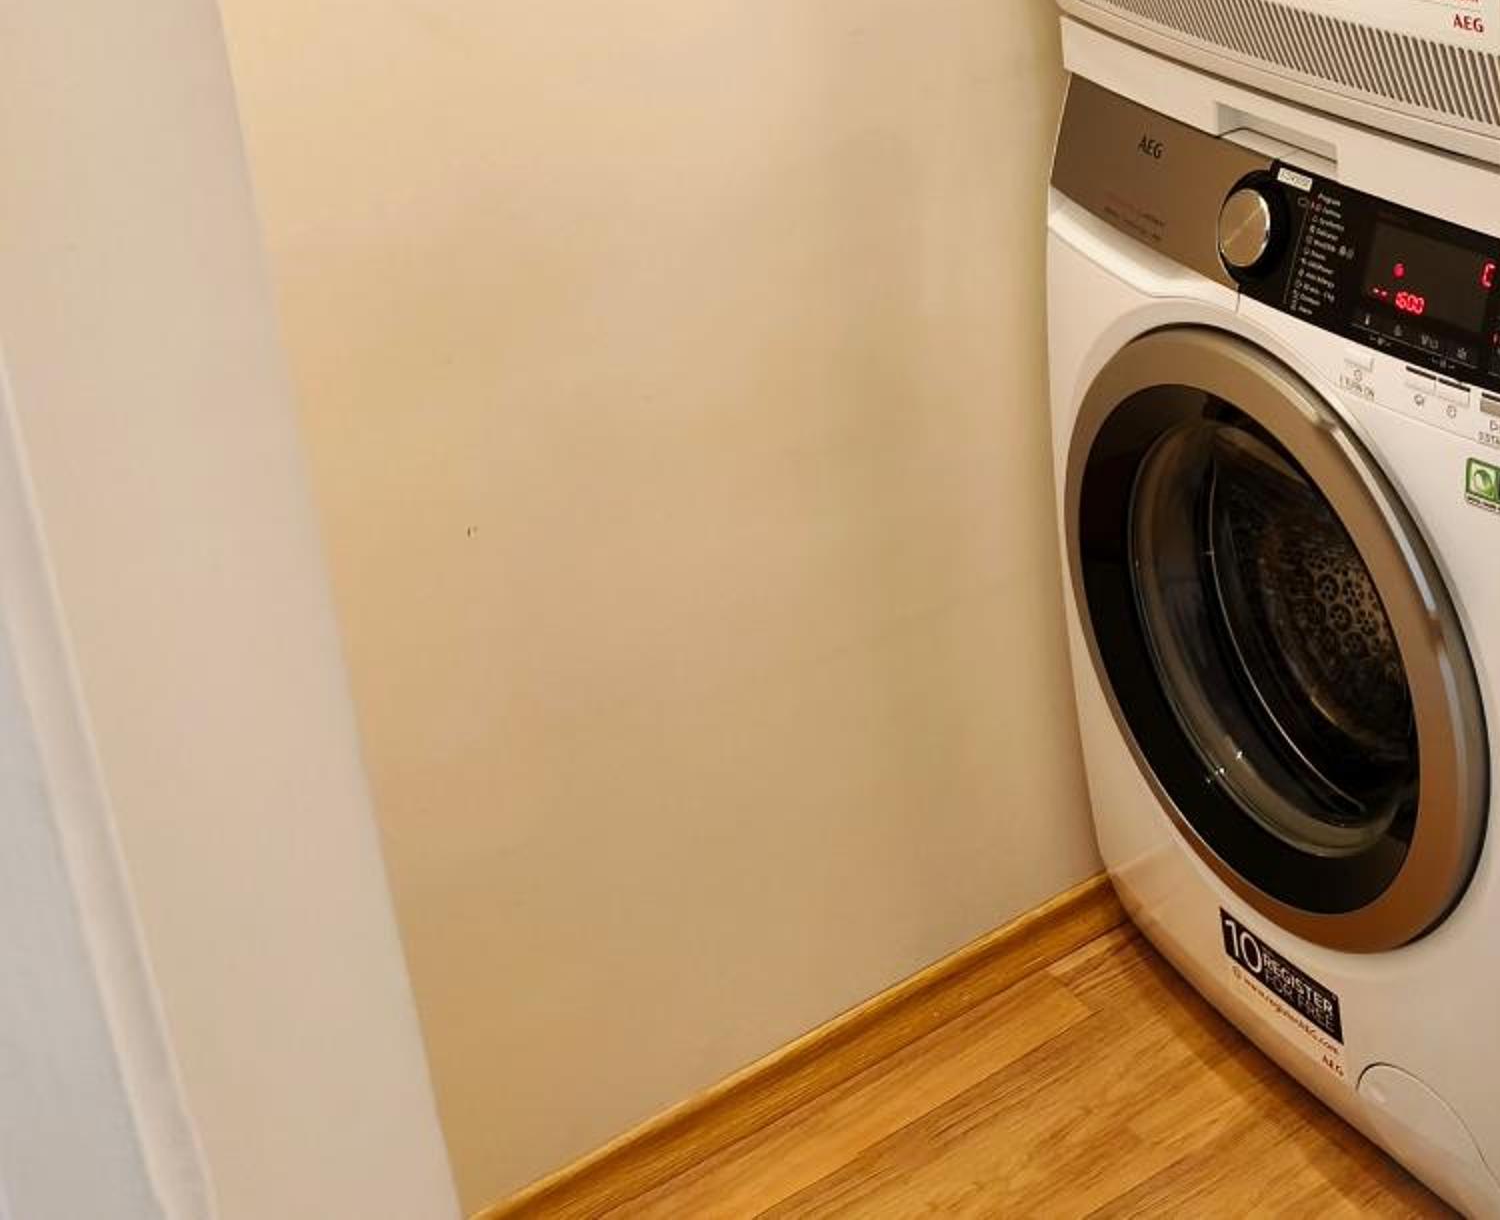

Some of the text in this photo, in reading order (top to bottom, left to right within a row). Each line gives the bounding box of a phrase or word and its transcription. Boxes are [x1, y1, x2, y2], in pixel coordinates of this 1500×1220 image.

[1453, 13, 1485, 33] AEG
[1137, 132, 1165, 160] AEG
[1224, 919, 1263, 974] 10
[1262, 952, 1334, 1014] REGISTER
